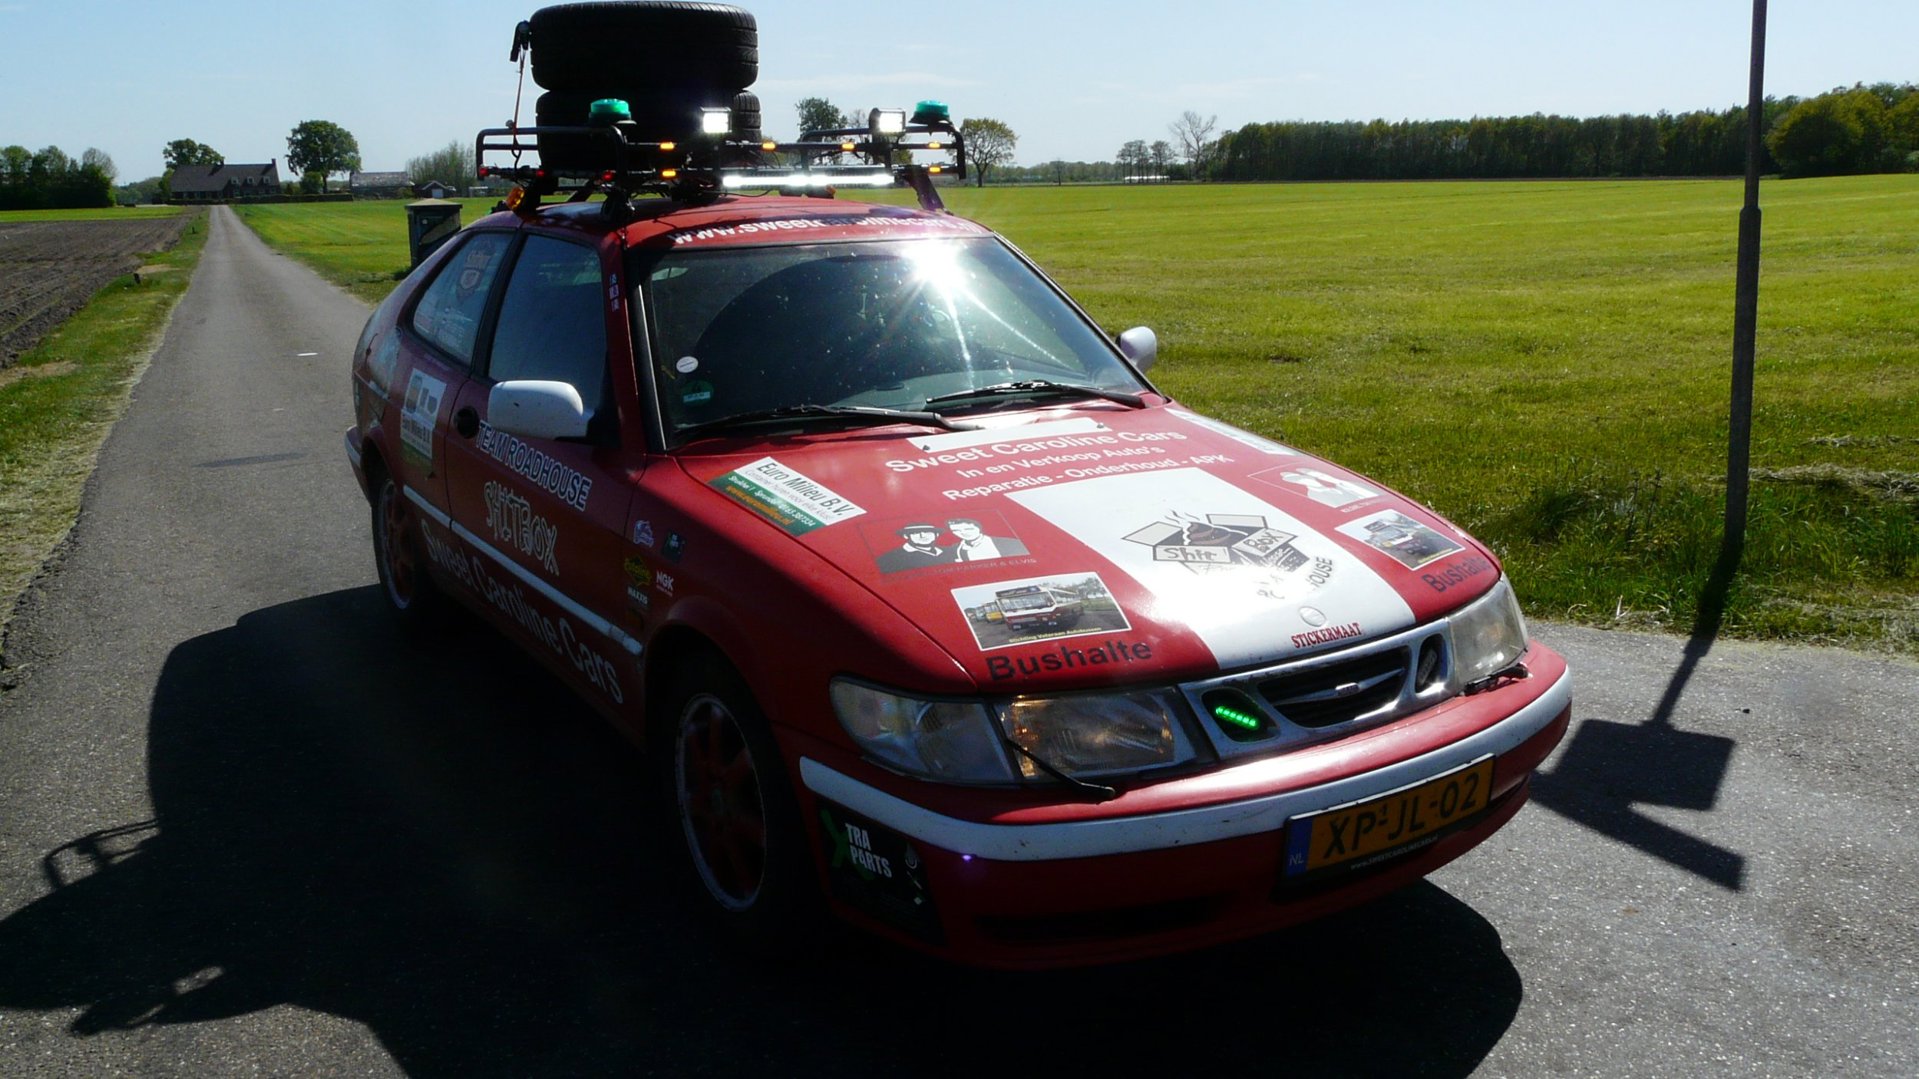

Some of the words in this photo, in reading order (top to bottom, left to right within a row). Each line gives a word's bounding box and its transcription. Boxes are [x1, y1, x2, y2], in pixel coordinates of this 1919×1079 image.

[475, 419, 510, 462] TEAM
[505, 437, 592, 512] ROADHOUSE
[885, 447, 994, 472] Sweet
[991, 433, 1119, 455] Caroline
[1117, 431, 1187, 442] Cars
[956, 469, 985, 478] In
[985, 463, 1015, 473] en
[1012, 450, 1101, 469] Verkoop
[1103, 446, 1166, 458] Auto's
[757, 462, 789, 481] Euro
[783, 477, 827, 502] Milieu
[820, 498, 856, 516] B.V.
[942, 475, 1053, 500] Reparatie
[1065, 458, 1180, 478] Onderhoud
[1190, 453, 1236, 465] APK
[656, 570, 674, 591] NGK
[421, 518, 480, 592] Sweet
[473, 556, 563, 654] Caroline
[559, 617, 623, 703] Cars
[1291, 623, 1362, 648] STICKERMAAT
[985, 641, 1153, 682] Bushalte
[849, 844, 892, 878] PARTS
[1289, 852, 1304, 866] NL
